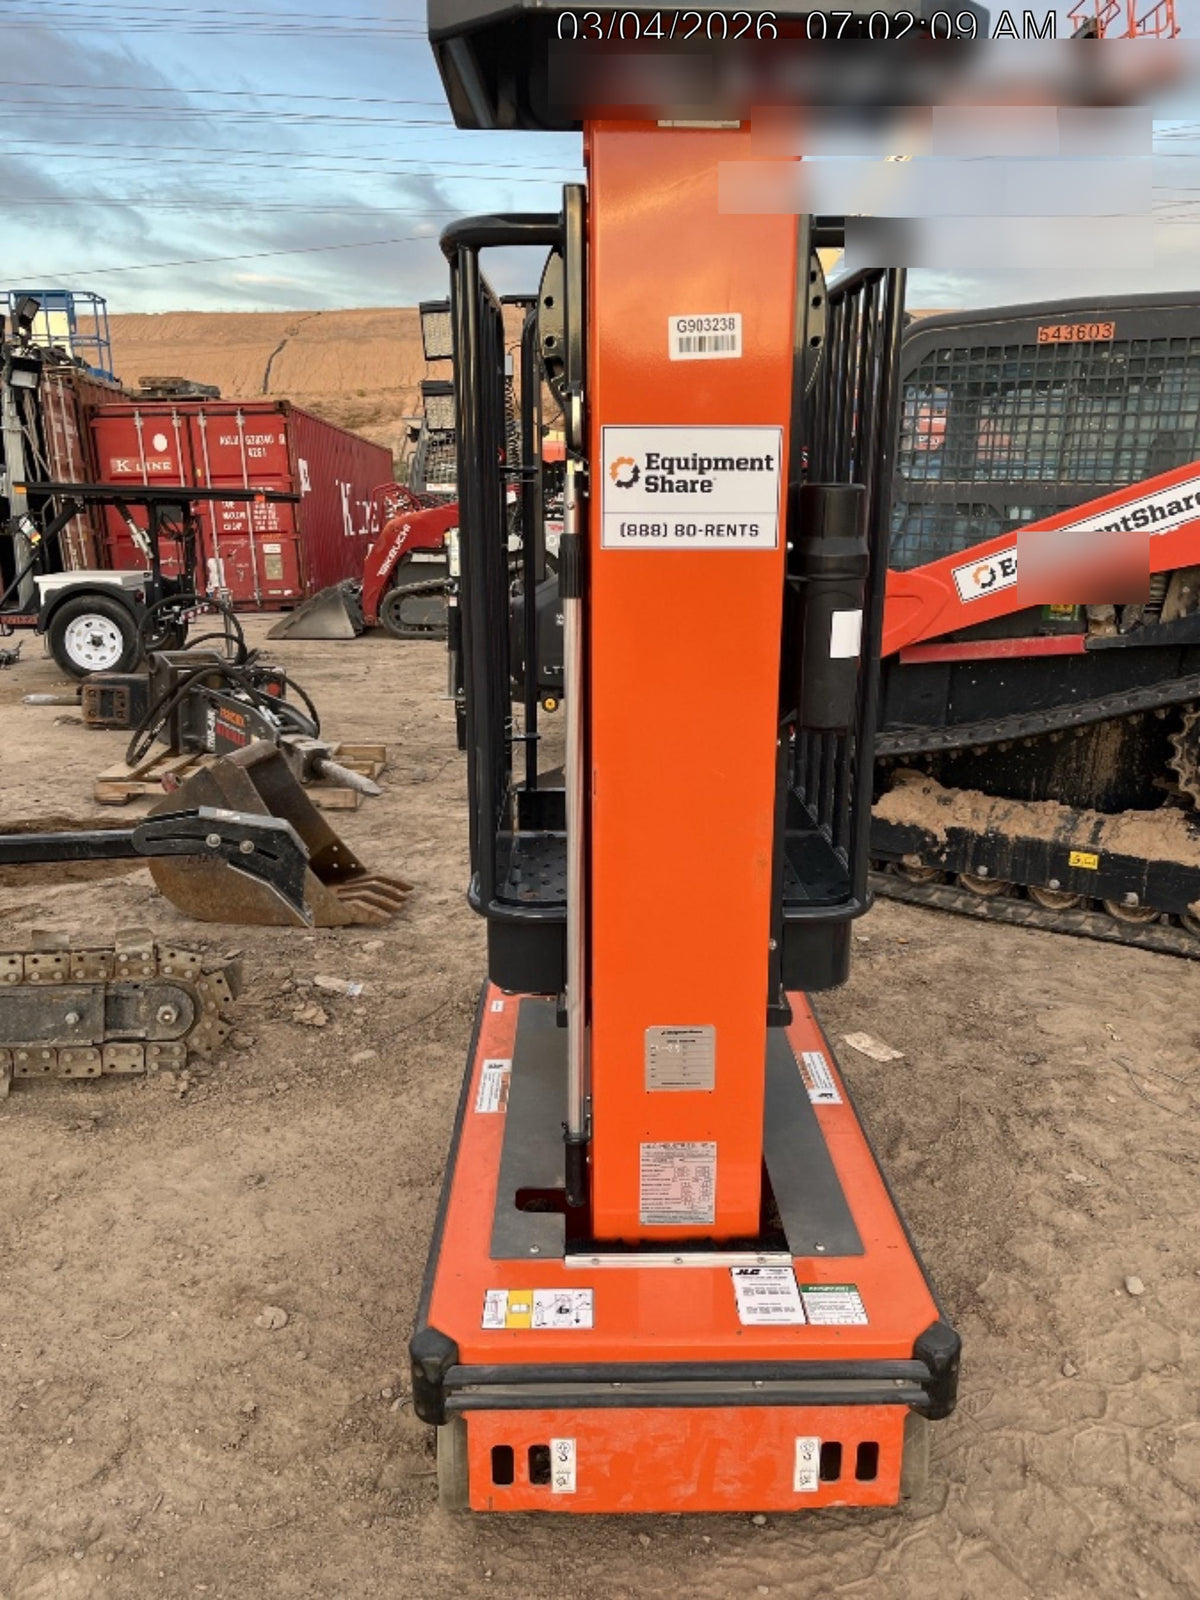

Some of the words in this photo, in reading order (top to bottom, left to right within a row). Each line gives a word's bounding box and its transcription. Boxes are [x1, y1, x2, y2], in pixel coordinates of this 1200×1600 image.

[676, 317, 736, 334] G903238
[1039, 323, 1112, 342] 543603
[115, 459, 132, 472] K
[644, 452, 774, 475] Equipment
[644, 475, 714, 494] Share
[620, 522, 668, 538] (888)
[674, 523, 760, 538] 80-RENTS
